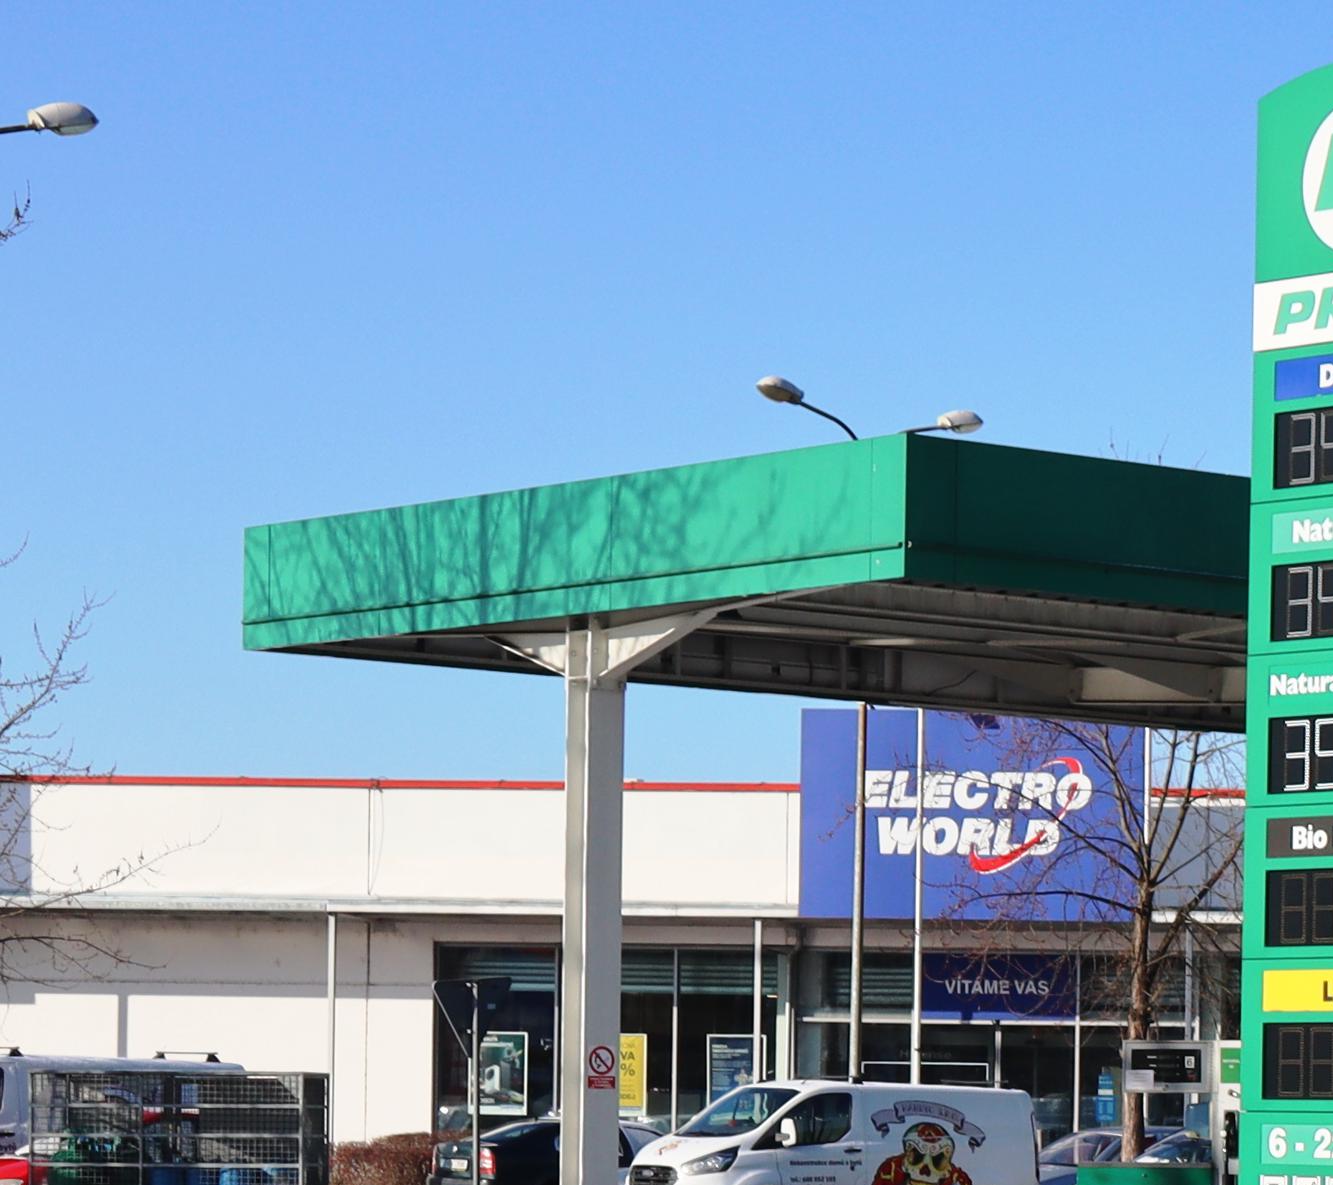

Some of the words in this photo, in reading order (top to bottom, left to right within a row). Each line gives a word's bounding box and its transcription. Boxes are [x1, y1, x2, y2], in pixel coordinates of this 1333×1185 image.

[864, 769, 1093, 811] ELECTRO
[877, 816, 1060, 857] WORLD
[1291, 824, 1329, 852] Bio
[1268, 1127, 1287, 1158] 6
